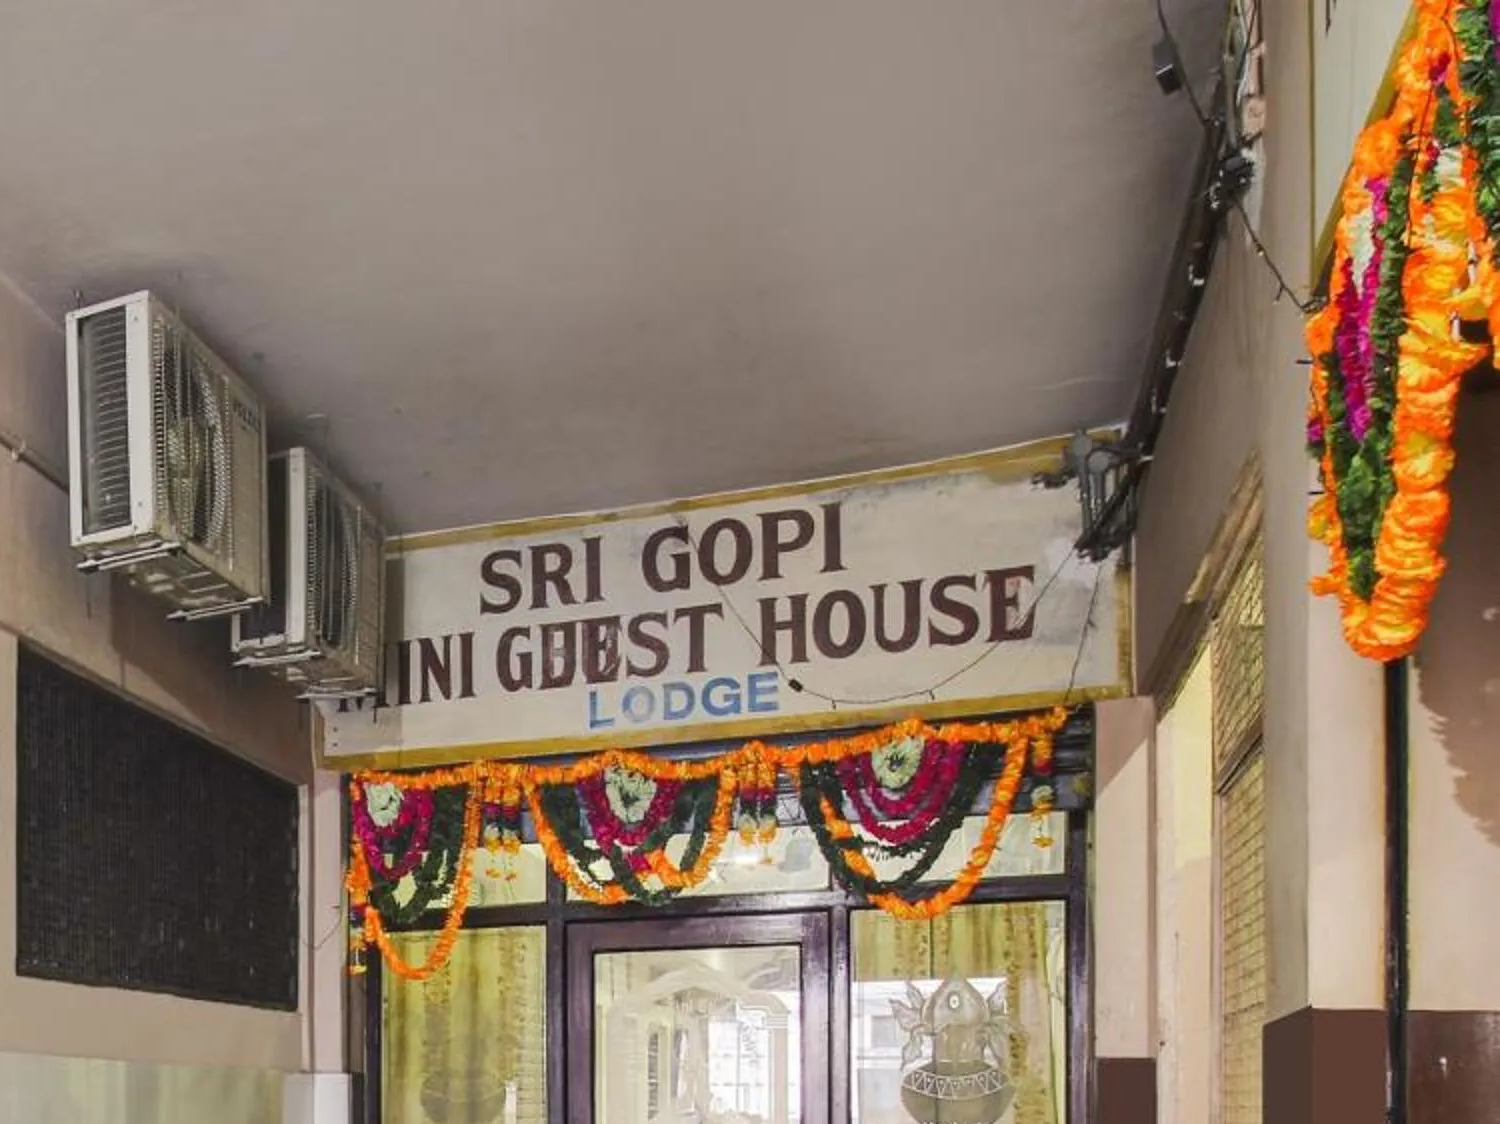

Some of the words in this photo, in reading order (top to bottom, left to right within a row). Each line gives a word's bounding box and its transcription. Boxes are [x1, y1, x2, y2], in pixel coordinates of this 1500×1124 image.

[479, 536, 606, 615] SRI
[641, 501, 848, 593] GOPI
[756, 565, 1037, 667] HOUSE
[588, 671, 780, 730] LODGE
